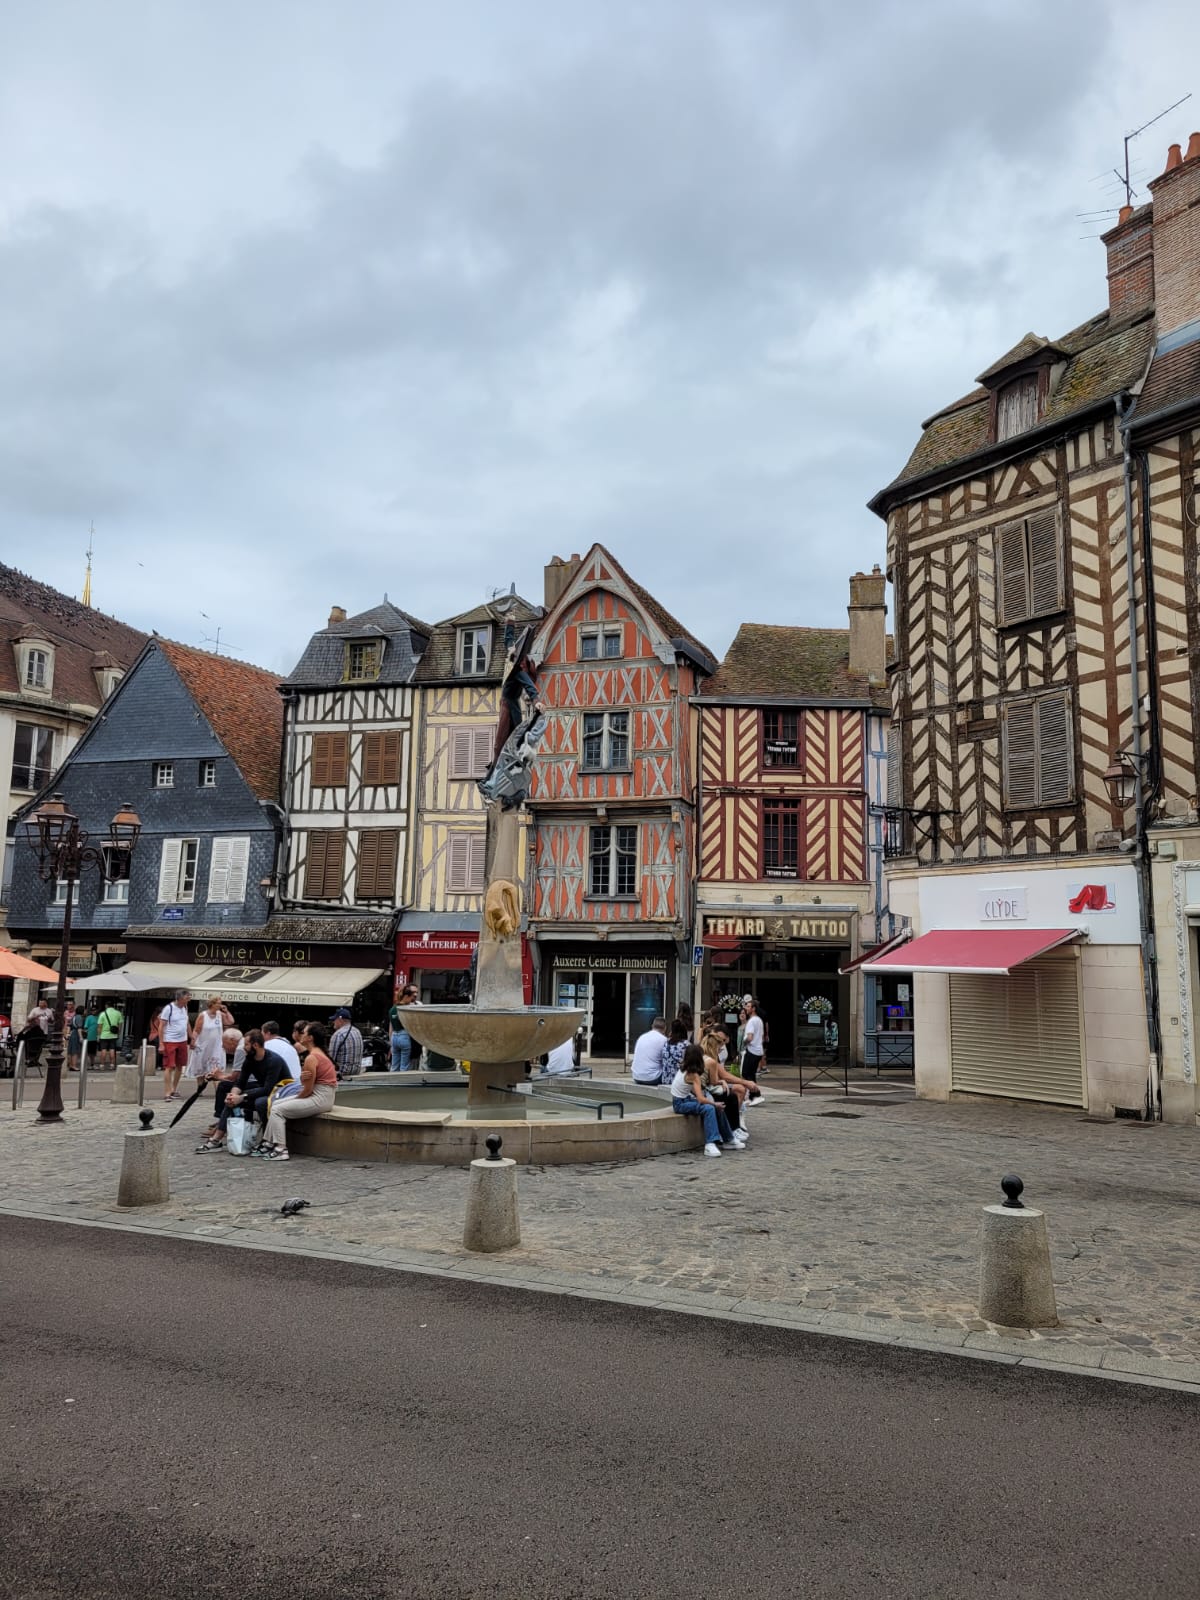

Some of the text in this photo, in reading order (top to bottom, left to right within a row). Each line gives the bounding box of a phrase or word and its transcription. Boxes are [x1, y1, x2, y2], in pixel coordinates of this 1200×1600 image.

[985, 898, 1017, 917] CLYDE
[706, 917, 848, 937] TETARD TATTOO
[195, 943, 311, 960] Olivier Vidal
[406, 940, 459, 949] BISCUITERIE
[460, 941, 469, 949] de
[553, 955, 668, 969] Auxerre Centre Immobilier
[220, 992, 249, 1001] France
[256, 993, 311, 1004] Chocolatier
